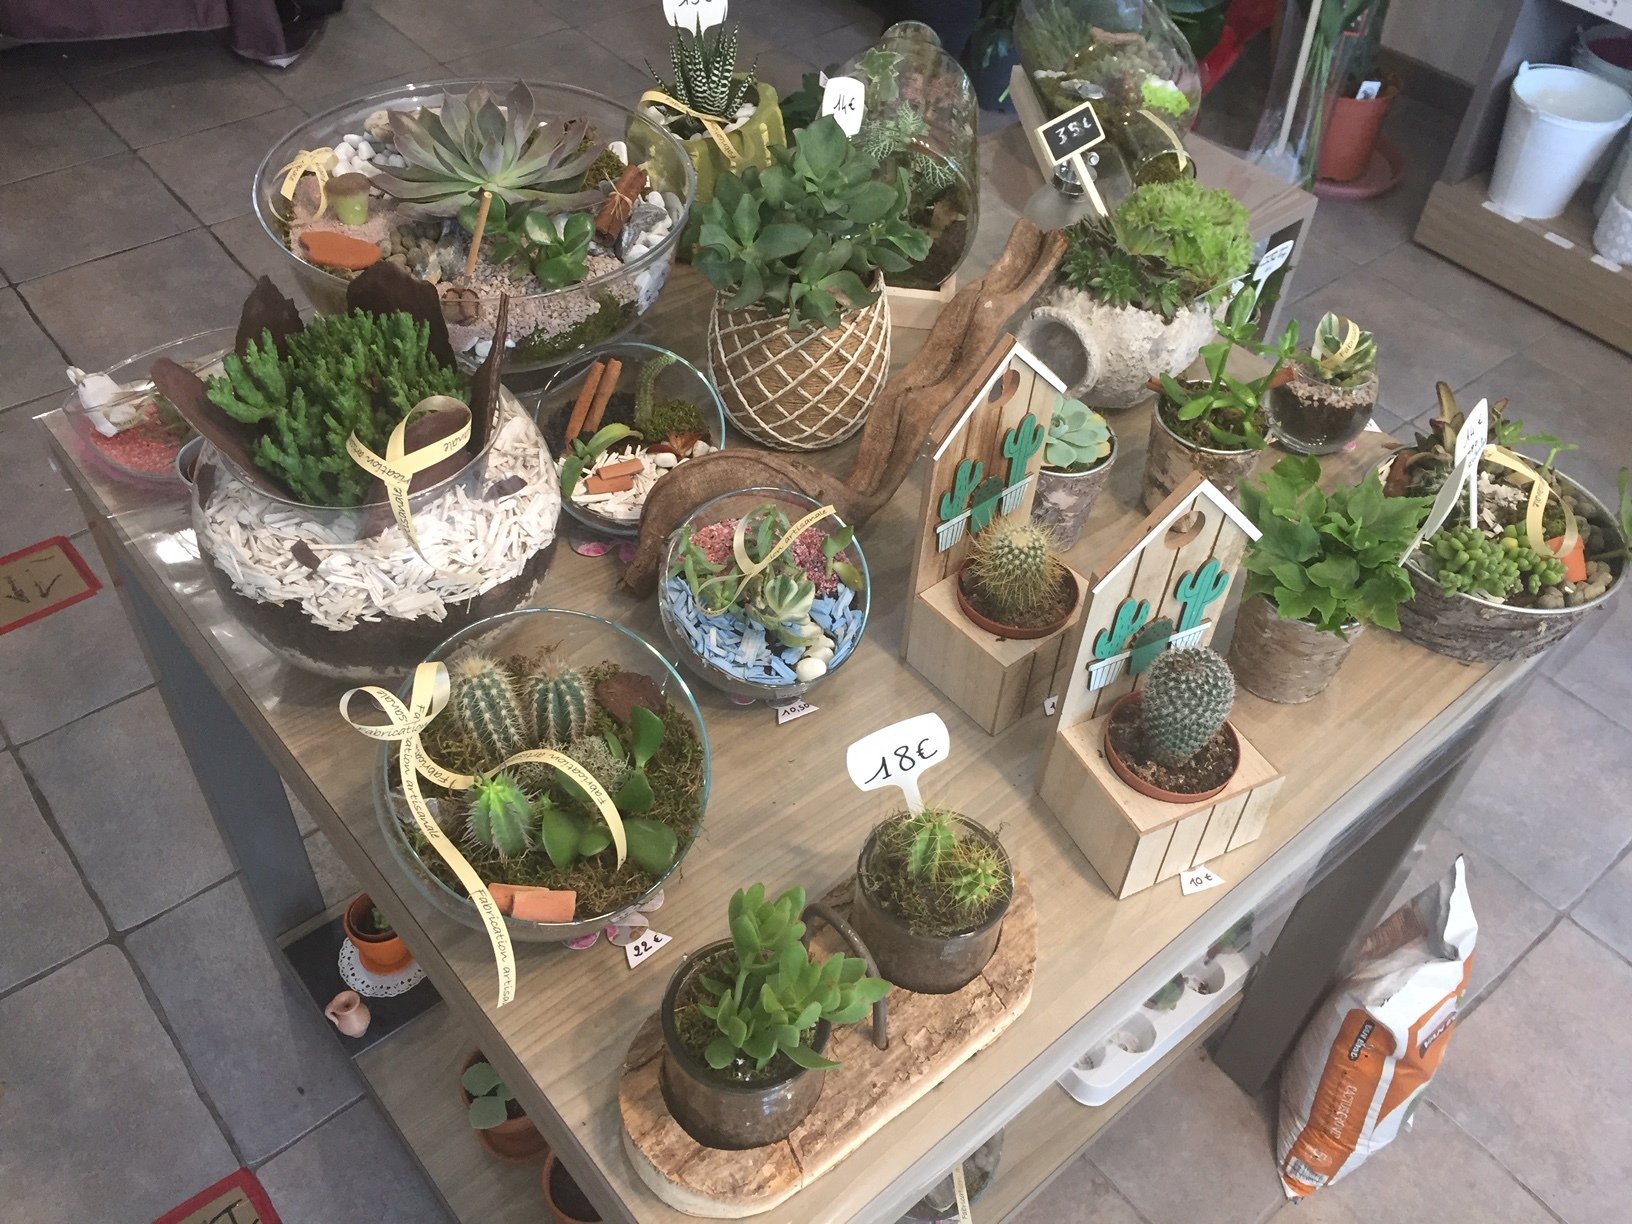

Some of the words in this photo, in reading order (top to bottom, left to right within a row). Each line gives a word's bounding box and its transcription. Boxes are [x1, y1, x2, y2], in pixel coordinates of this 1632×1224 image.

[549, 753, 606, 806] Fabrication
[405, 780, 440, 839] artisanale
[478, 889, 509, 962] Fabrication
